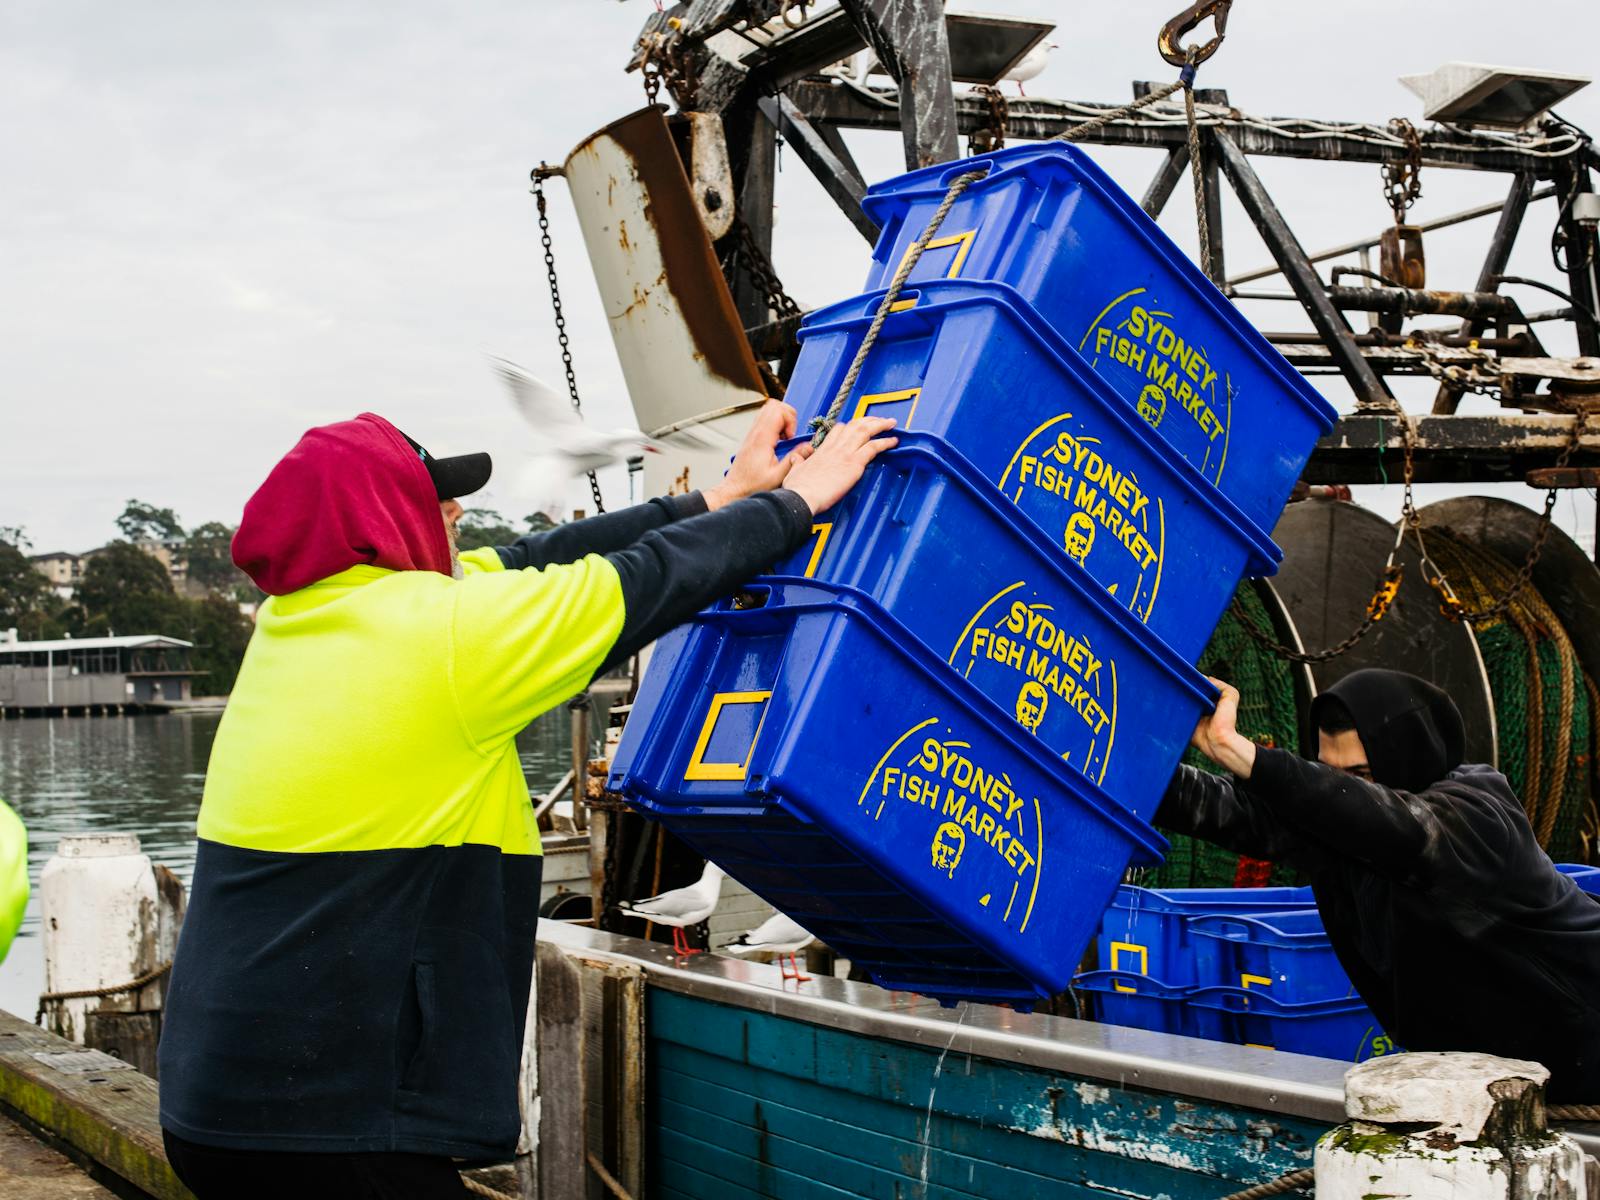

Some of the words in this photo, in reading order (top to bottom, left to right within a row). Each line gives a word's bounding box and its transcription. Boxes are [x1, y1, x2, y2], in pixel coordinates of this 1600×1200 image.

[1095, 327, 1146, 373] FISH
[1145, 354, 1225, 442] MARKET
[1127, 306, 1218, 390] SYDNEY
[1019, 455, 1073, 501] FISH
[1073, 480, 1158, 571] MARKET
[1053, 432, 1149, 517] SYDNEY
[970, 628, 1026, 671] FISH
[1025, 649, 1110, 735] MARKET
[1006, 601, 1103, 682] SYDNEY
[882, 767, 940, 810] FISH
[941, 788, 1035, 876] MARKET
[919, 738, 1025, 820] SYDNEY
